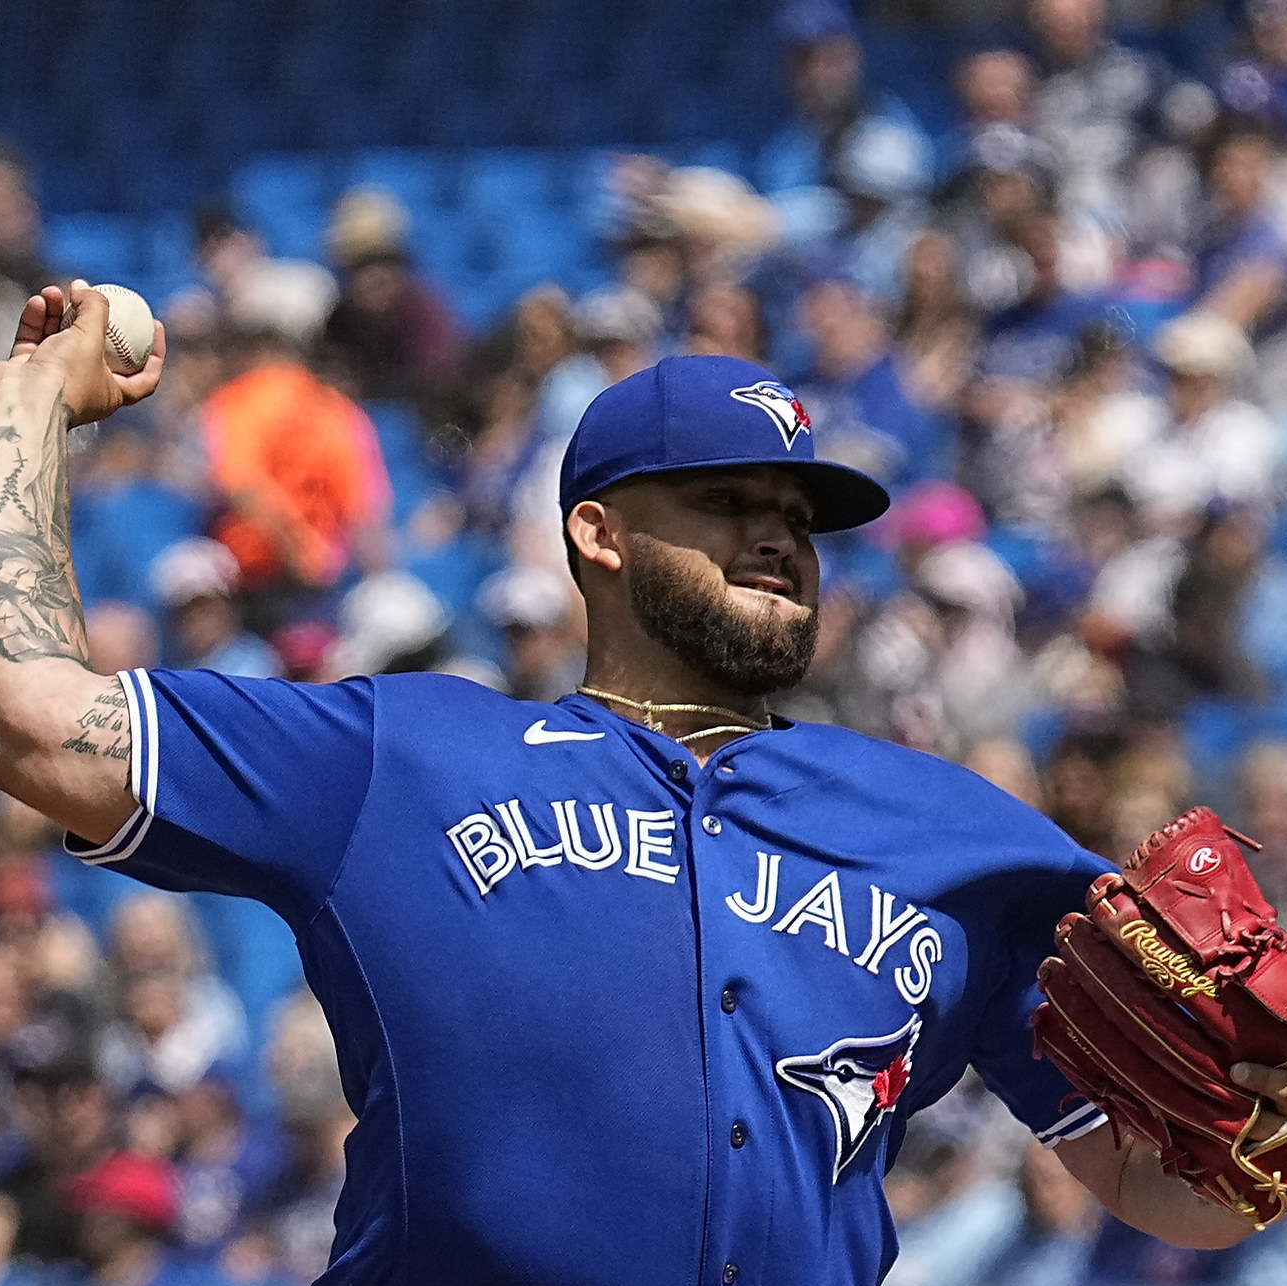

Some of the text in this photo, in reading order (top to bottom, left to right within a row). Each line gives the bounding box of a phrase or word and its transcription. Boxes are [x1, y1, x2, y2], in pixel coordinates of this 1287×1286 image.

[76, 708, 123, 731] Lord is
[61, 730, 99, 755] whom
[1190, 847, 1219, 872] R
[446, 798, 943, 1005] BLUE JAYS
[1120, 920, 1221, 998] Rawlings
